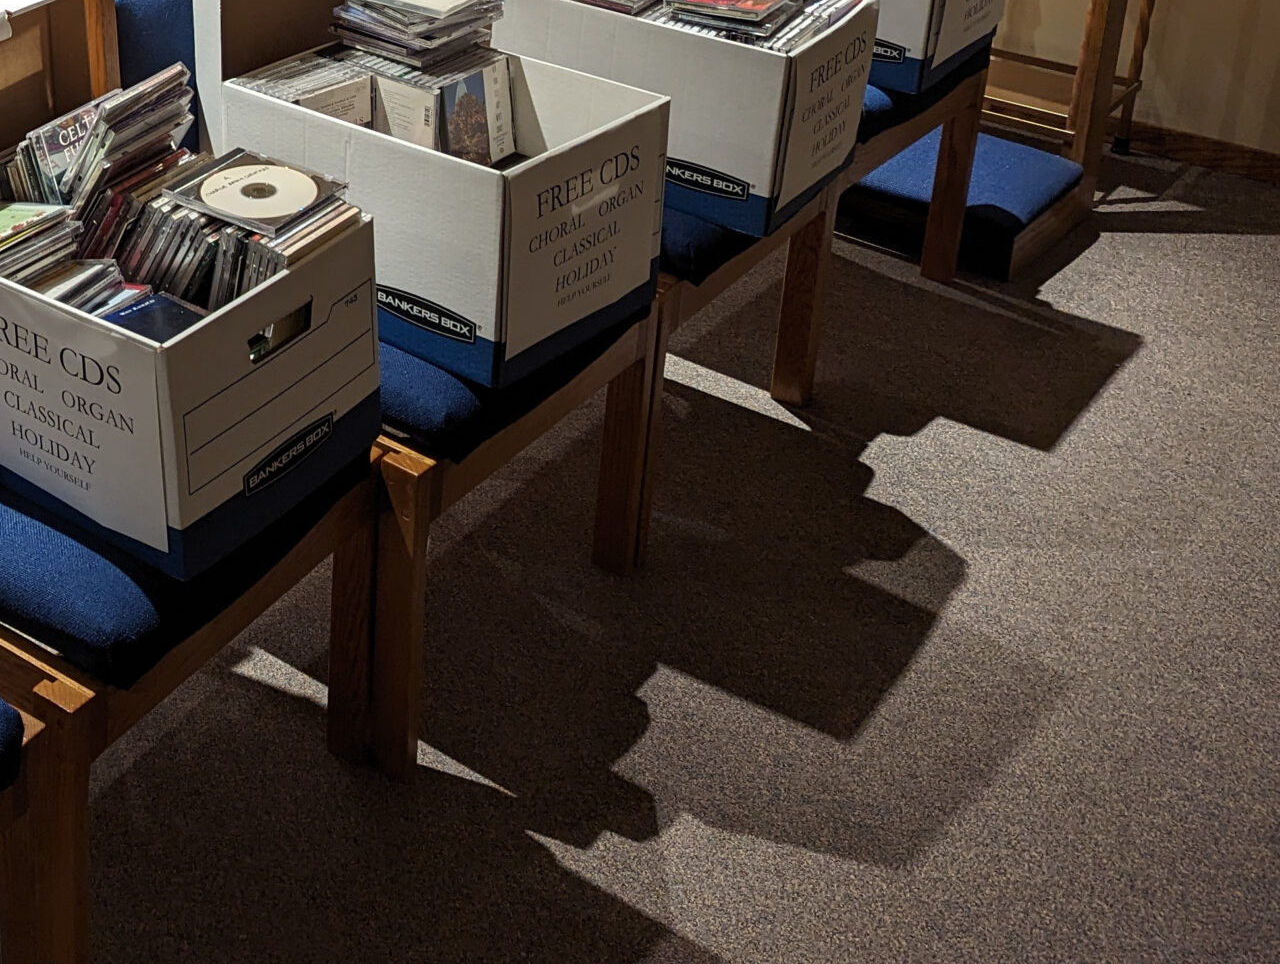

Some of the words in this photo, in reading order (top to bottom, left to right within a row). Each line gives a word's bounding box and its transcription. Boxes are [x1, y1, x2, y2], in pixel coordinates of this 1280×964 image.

[810, 51, 842, 92] FREE
[845, 31, 866, 64] CDS
[874, 46, 900, 58] BOX
[59, 113, 95, 146] CELT
[536, 168, 593, 220] FREE
[600, 146, 640, 184] CDS
[666, 165, 711, 185] NKERS
[713, 179, 743, 194] BOX
[528, 214, 586, 253] CHORAL
[598, 180, 644, 217] ORGAN
[554, 221, 620, 268] CLASSICAL
[555, 246, 616, 292] HOLIDAY
[378, 292, 439, 324] BANKERS
[441, 317, 470, 336] BOX
[60, 348, 122, 394] CDS
[4, 390, 100, 448] CLASSICAL
[62, 390, 134, 435] ORGAN
[11, 420, 96, 474] HOLIDAY
[20, 448, 42, 465] HELP
[44, 460, 92, 492] YOURSELF
[249, 441, 304, 488] BANKERS
[306, 422, 330, 447] BOX
